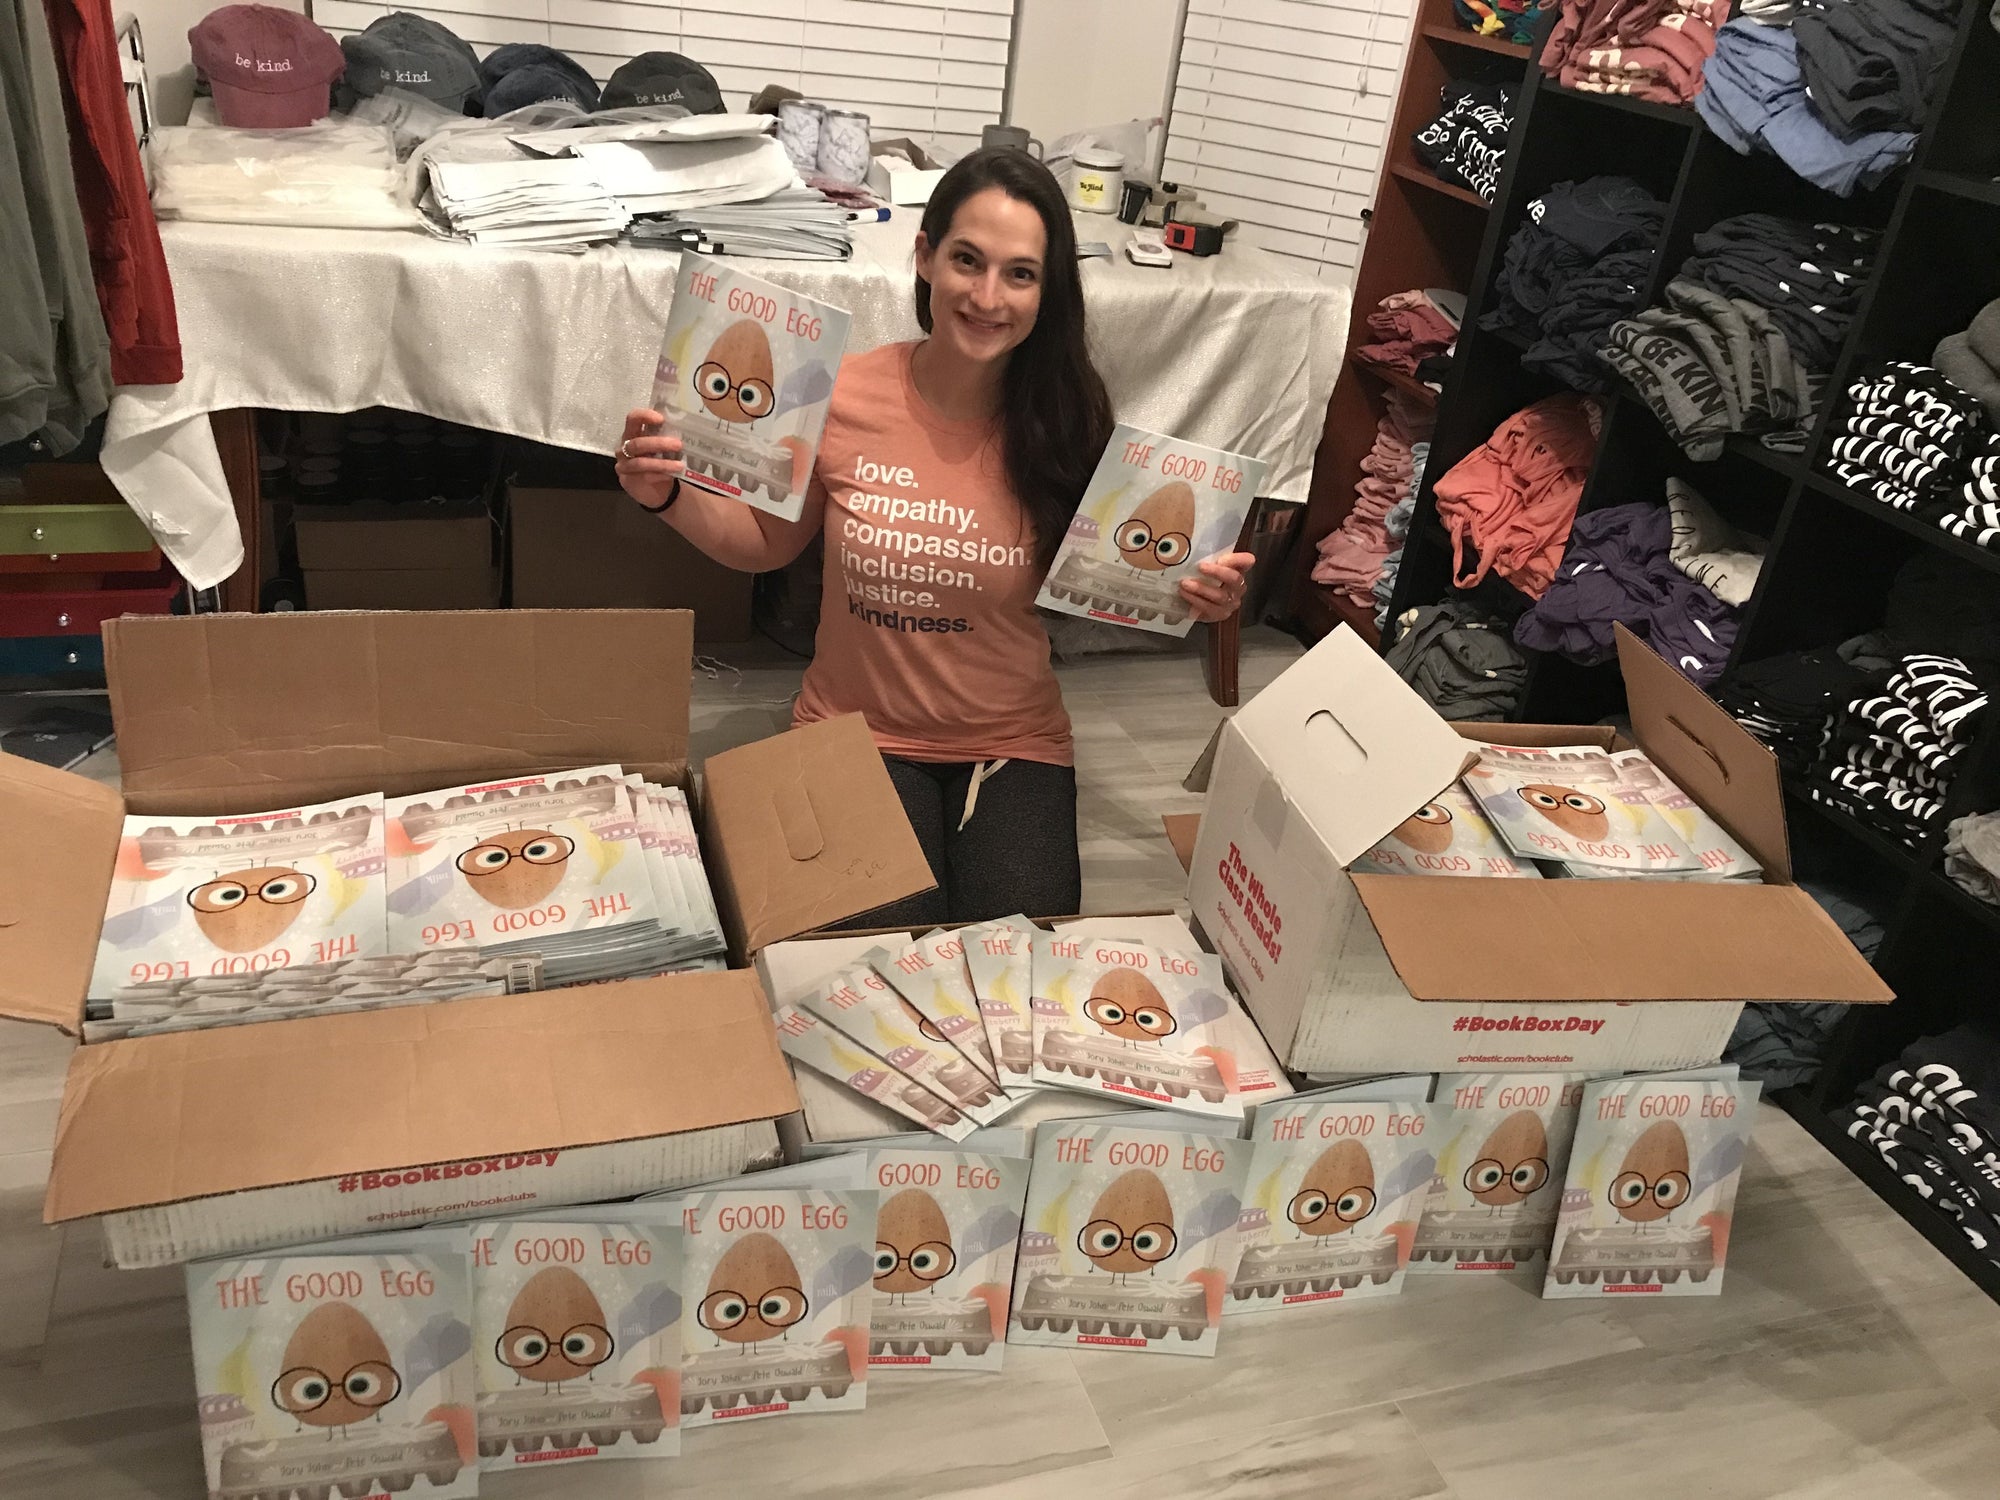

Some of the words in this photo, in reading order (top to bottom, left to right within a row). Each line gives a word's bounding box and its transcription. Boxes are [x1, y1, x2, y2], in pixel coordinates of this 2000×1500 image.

[235, 53, 251, 68] be
[635, 93, 649, 104] be
[689, 271, 719, 303] THE
[728, 287, 777, 323] GOOD
[786, 307, 822, 342] EGG
[1671, 361, 1728, 416] KIN
[854, 455, 919, 488] love.
[1122, 442, 1156, 469] THE
[1161, 453, 1207, 482] GOOD
[1212, 465, 1243, 494] EGG
[848, 490, 979, 533] empathy.
[843, 518, 1031, 566] compassion.
[841, 542, 982, 591] inclusion.
[848, 594, 974, 634] kindness.
[1526, 831, 1570, 850] EGG
[1576, 842, 1631, 859] GOOD
[1645, 843, 1680, 860] THE
[1415, 853, 1471, 871] GOOD
[1228, 841, 1248, 883] The
[1247, 872, 1282, 934] Whole
[493, 904, 566, 933] GOOD
[582, 892, 631, 918] THE
[1218, 859, 1244, 907] Class
[1244, 897, 1282, 964] Reads!
[421, 919, 476, 946] EGG
[311, 934, 359, 963] THE
[980, 939, 1017, 956] THE
[1050, 941, 1083, 960] THE
[1095, 948, 1148, 969] GOOD
[1160, 957, 1199, 977] EGG
[130, 960, 190, 982] EGG
[212, 948, 291, 975] GOOD
[894, 951, 934, 975] THE
[826, 985, 867, 1010] THE
[777, 1011, 817, 1038] THE
[1453, 1015, 1606, 1035] #BookBoxDay
[1457, 1055, 1574, 1063] scholastic.com/bookclubs
[1454, 1086, 1487, 1110] THE
[1499, 1085, 1550, 1109] GOOD
[1560, 1085, 1584, 1107] EG
[1597, 1095, 1628, 1120] THE
[1639, 1094, 1690, 1118] GOOD
[1700, 1095, 1736, 1118] EGG
[1272, 1116, 1307, 1142] THE
[1319, 1114, 1375, 1139] GOOD
[1386, 1114, 1426, 1136] EGG
[1056, 1137, 1094, 1164] THE
[1108, 1142, 1169, 1167] GOOD
[1182, 1147, 1225, 1173] EGG
[337, 1151, 560, 1193] #BookBoxDay
[878, 1163, 941, 1187] GOOD
[956, 1165, 1000, 1190] EGG
[366, 1190, 537, 1223] scholastic.com/bookclubs
[718, 1204, 785, 1233] GOOD
[801, 1204, 848, 1230] EGG
[470, 1238, 498, 1267] HE
[514, 1237, 585, 1265] GOOD
[603, 1239, 652, 1265] EGG
[216, 1275, 269, 1310] THE
[286, 1270, 363, 1303] GOOD
[380, 1269, 435, 1298] EGG
[1087, 1336, 1146, 1346] SCHOLASTIC
